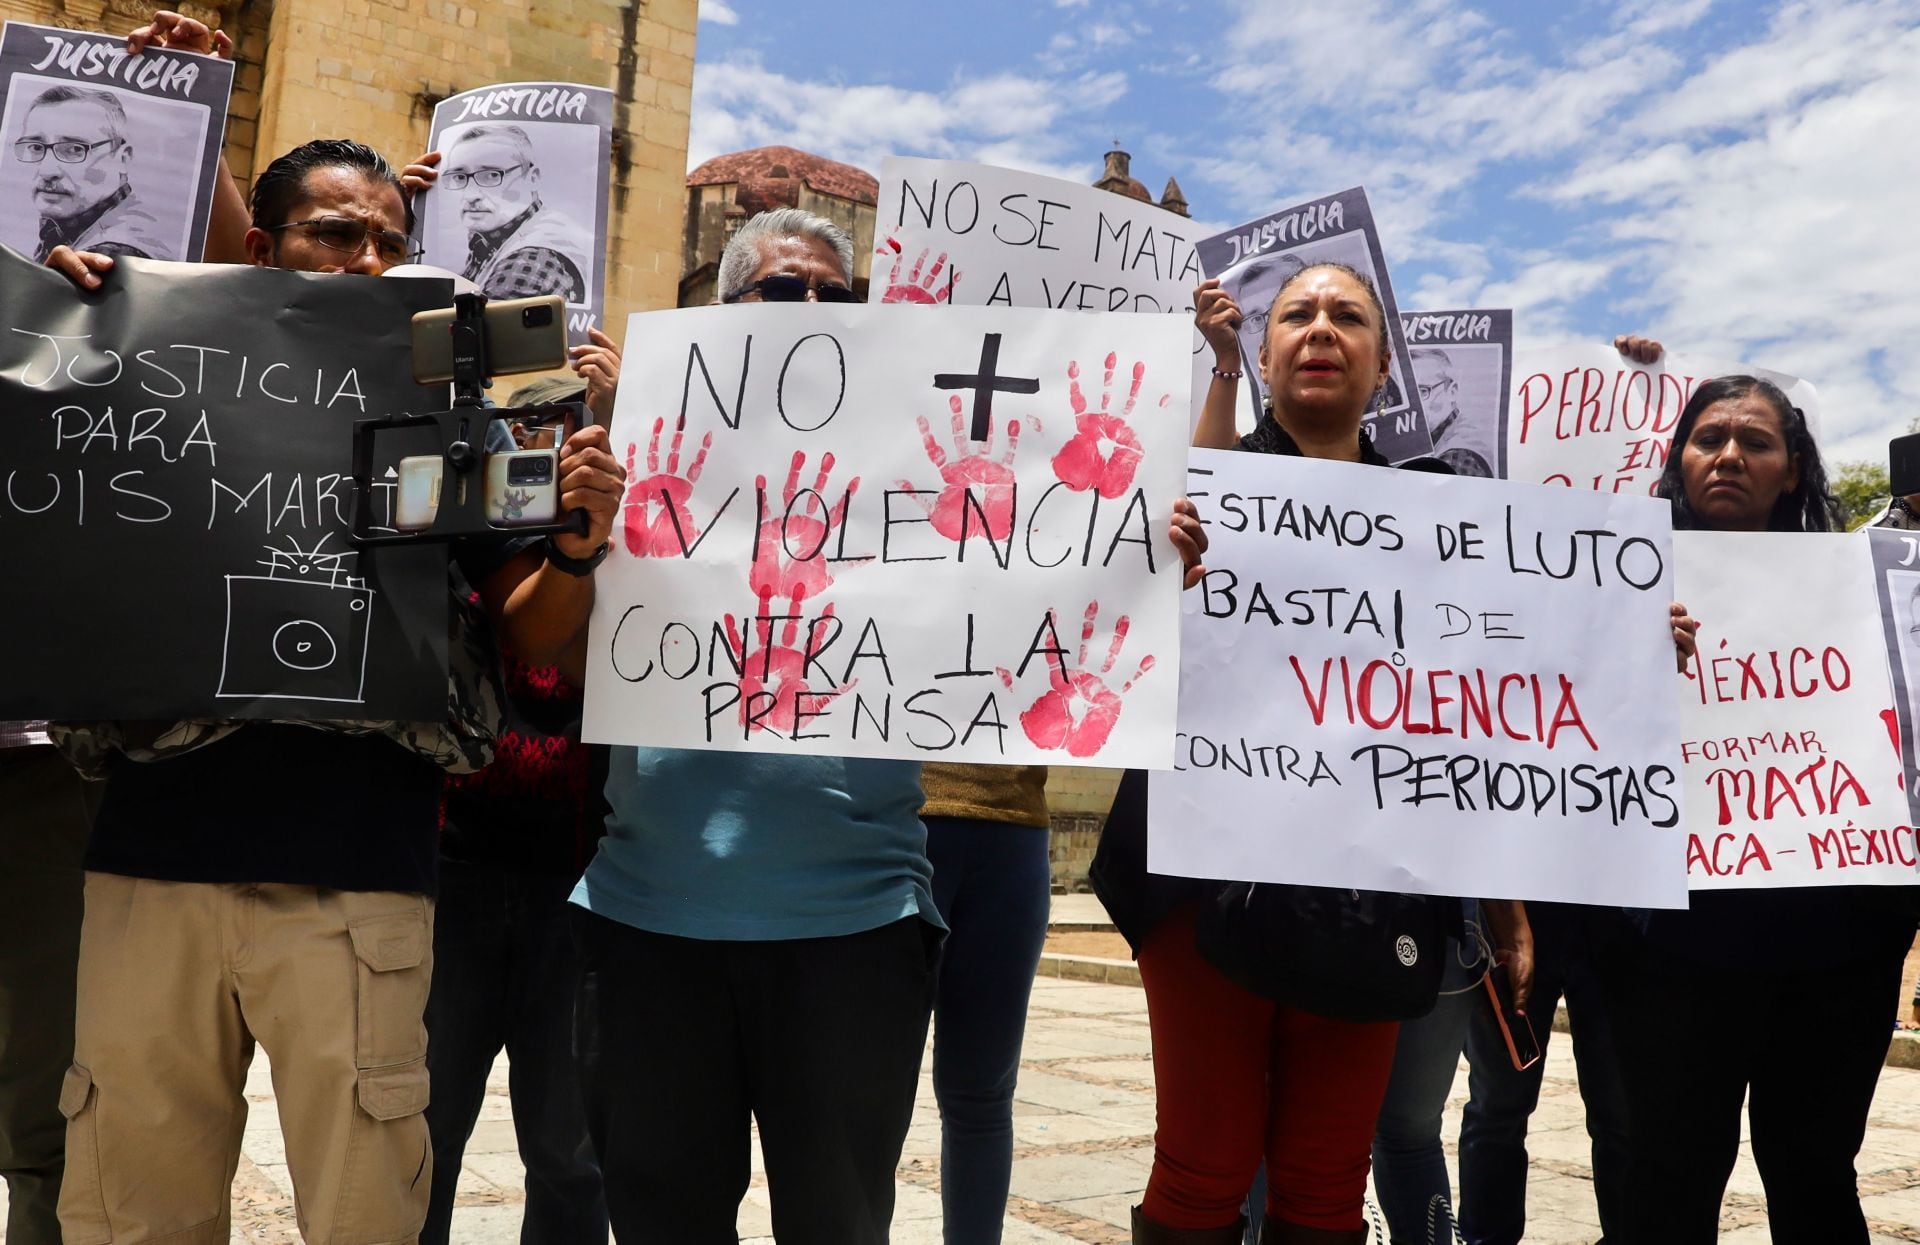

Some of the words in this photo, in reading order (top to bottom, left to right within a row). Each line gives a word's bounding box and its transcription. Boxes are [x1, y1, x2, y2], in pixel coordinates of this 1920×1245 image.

[30, 36, 201, 98] JUSTICIA
[452, 89, 588, 122] JUSTICIA
[899, 179, 979, 235] NO
[992, 194, 1071, 252] SE
[1094, 212, 1200, 285] MATA
[1225, 200, 1344, 265] JUSTICIA
[1402, 313, 1492, 342] USTICIA
[11, 327, 367, 412] JUSTICIA
[679, 333, 847, 431] NO
[52, 405, 217, 466] PARA
[1395, 411, 1417, 435] NI
[1518, 367, 1713, 444] PERIODI
[3, 469, 172, 525] UIS
[660, 481, 1158, 575] VIOLENCIA
[1436, 521, 1486, 562] DE
[1506, 504, 1664, 591] LUTO
[611, 604, 894, 686] CONTRA
[934, 611, 1072, 686] LA
[1434, 603, 1526, 641] DE
[701, 681, 1009, 756] PRENSA
[1288, 655, 1600, 752] VIOLENCIA
[1680, 730, 1828, 764] FORMAR
[1351, 743, 1681, 828] PERIODISTAS
[1686, 831, 1773, 877] ACA
[1807, 820, 1920, 871] MÉXIC
